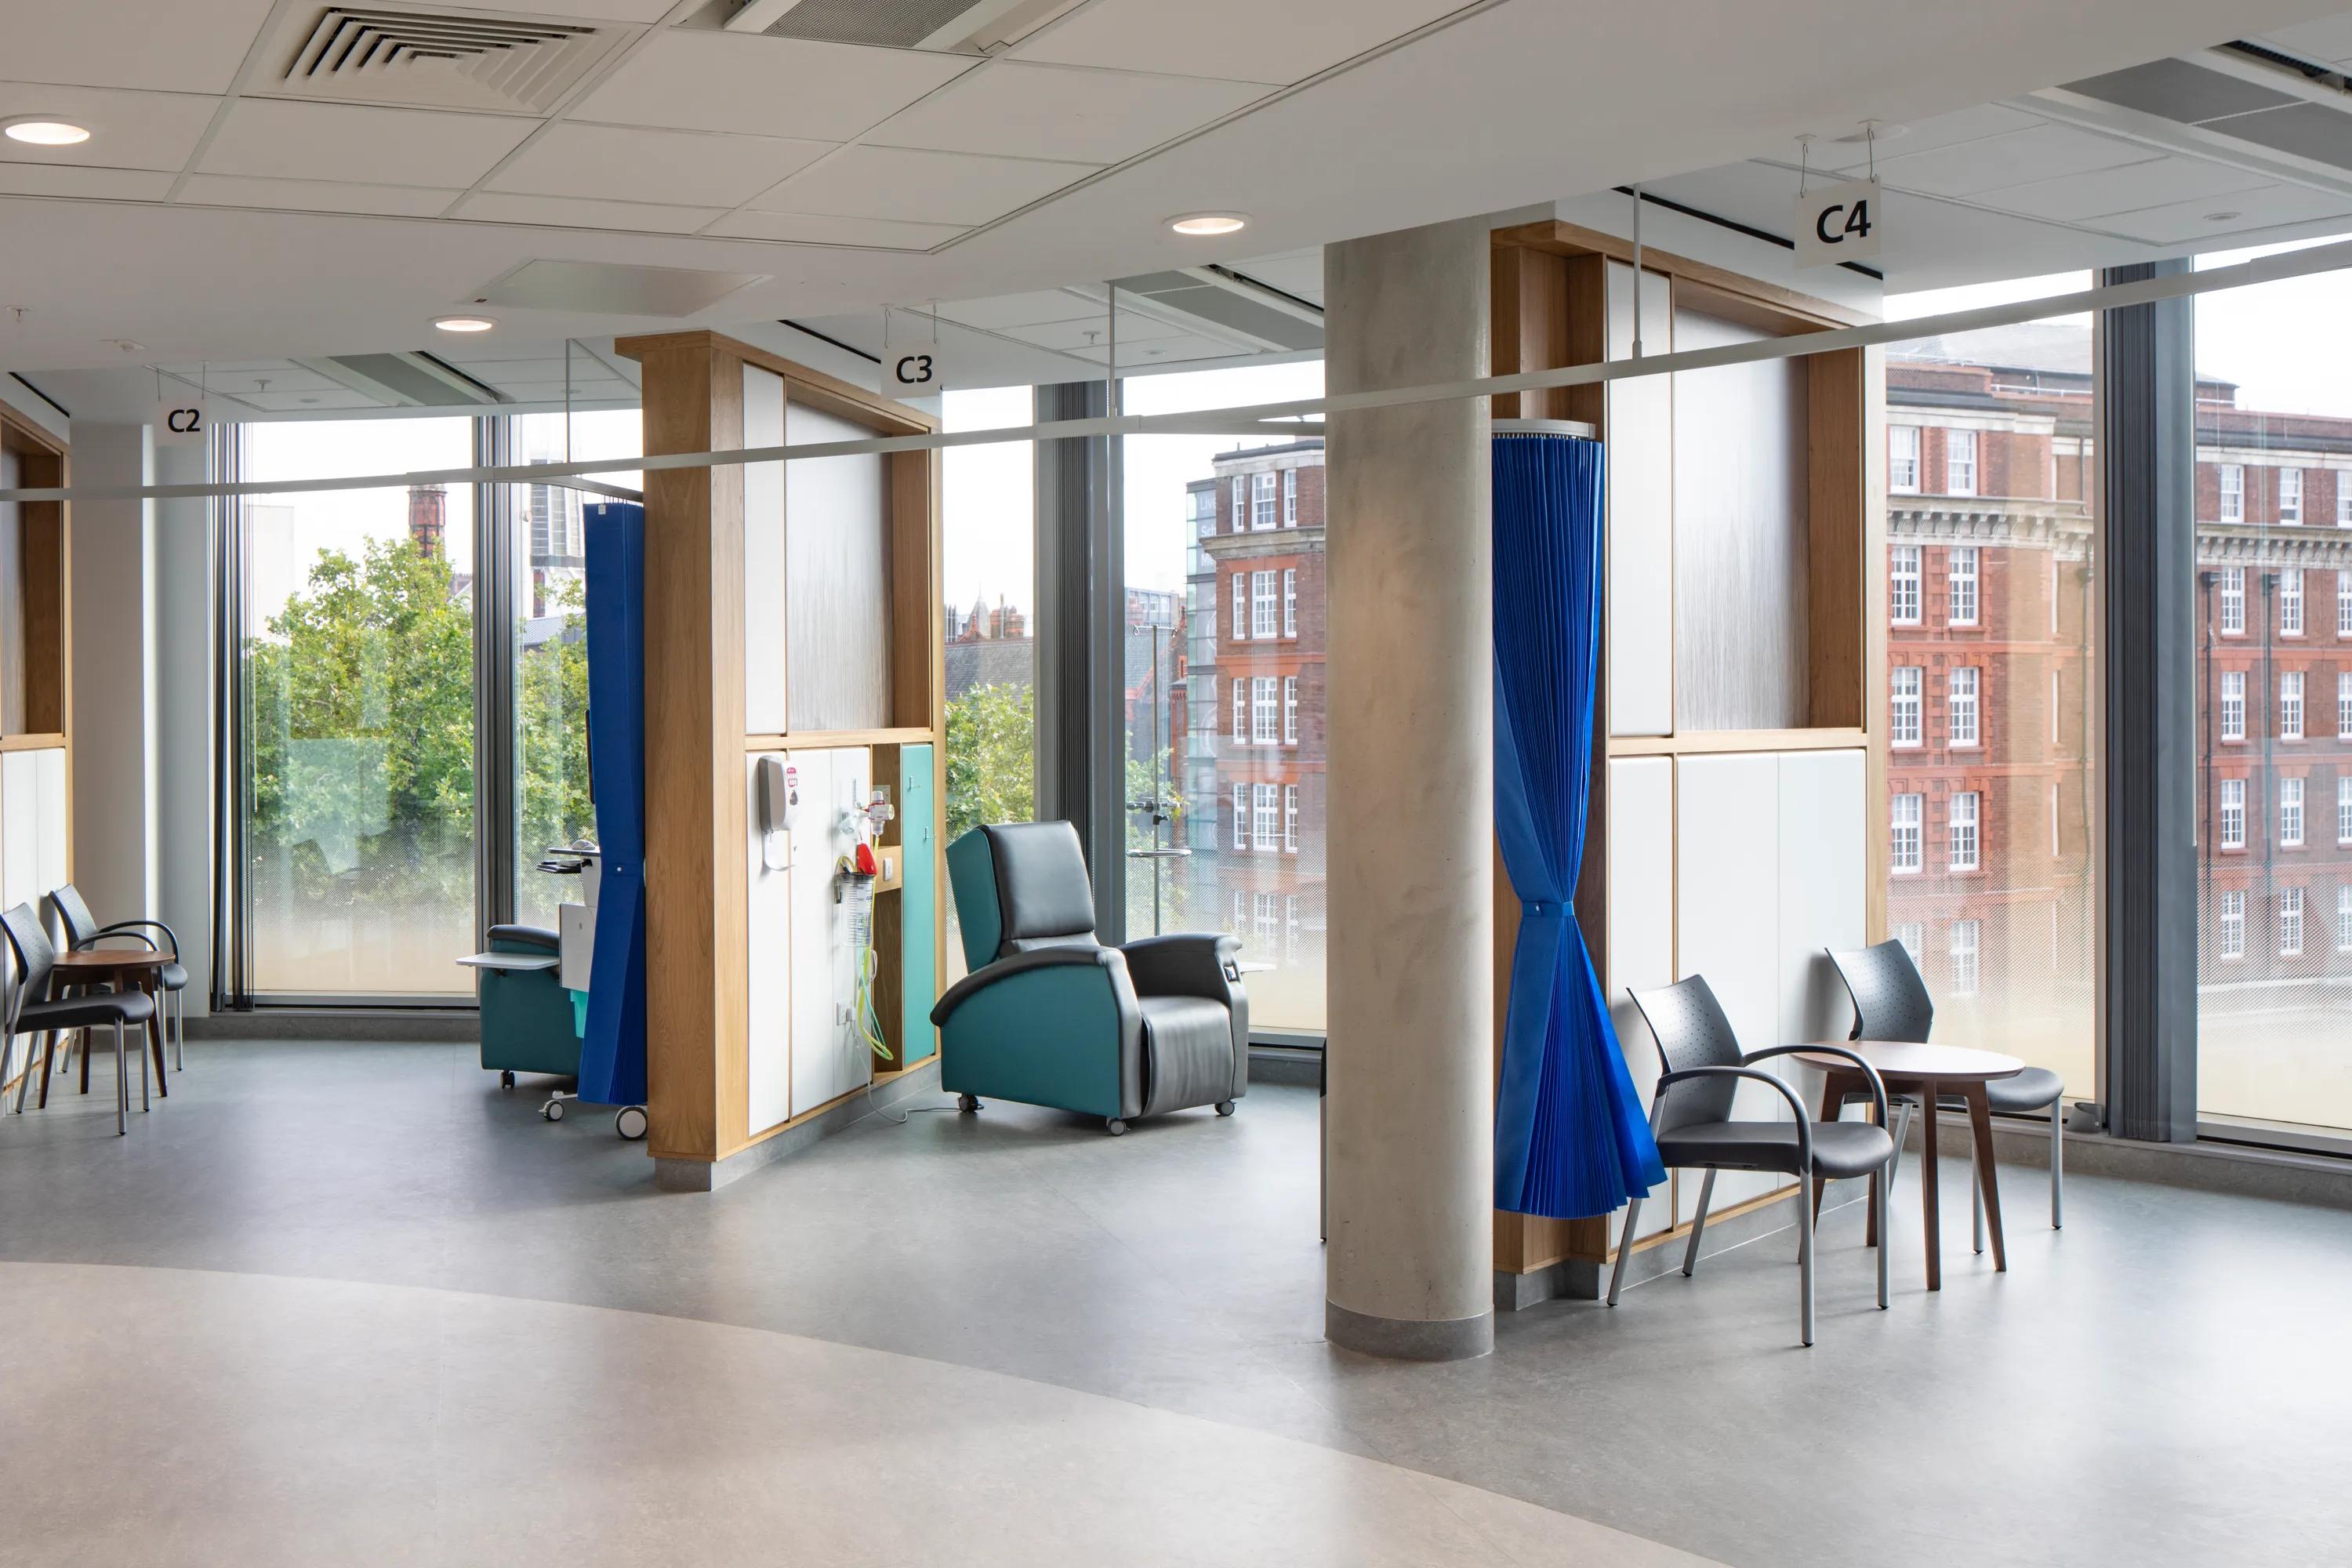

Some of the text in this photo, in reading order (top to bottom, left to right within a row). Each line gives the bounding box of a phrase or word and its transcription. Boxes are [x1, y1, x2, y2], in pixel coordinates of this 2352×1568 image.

[1817, 199, 1871, 244] C4
[896, 355, 932, 383] C3
[168, 408, 201, 433] C2
